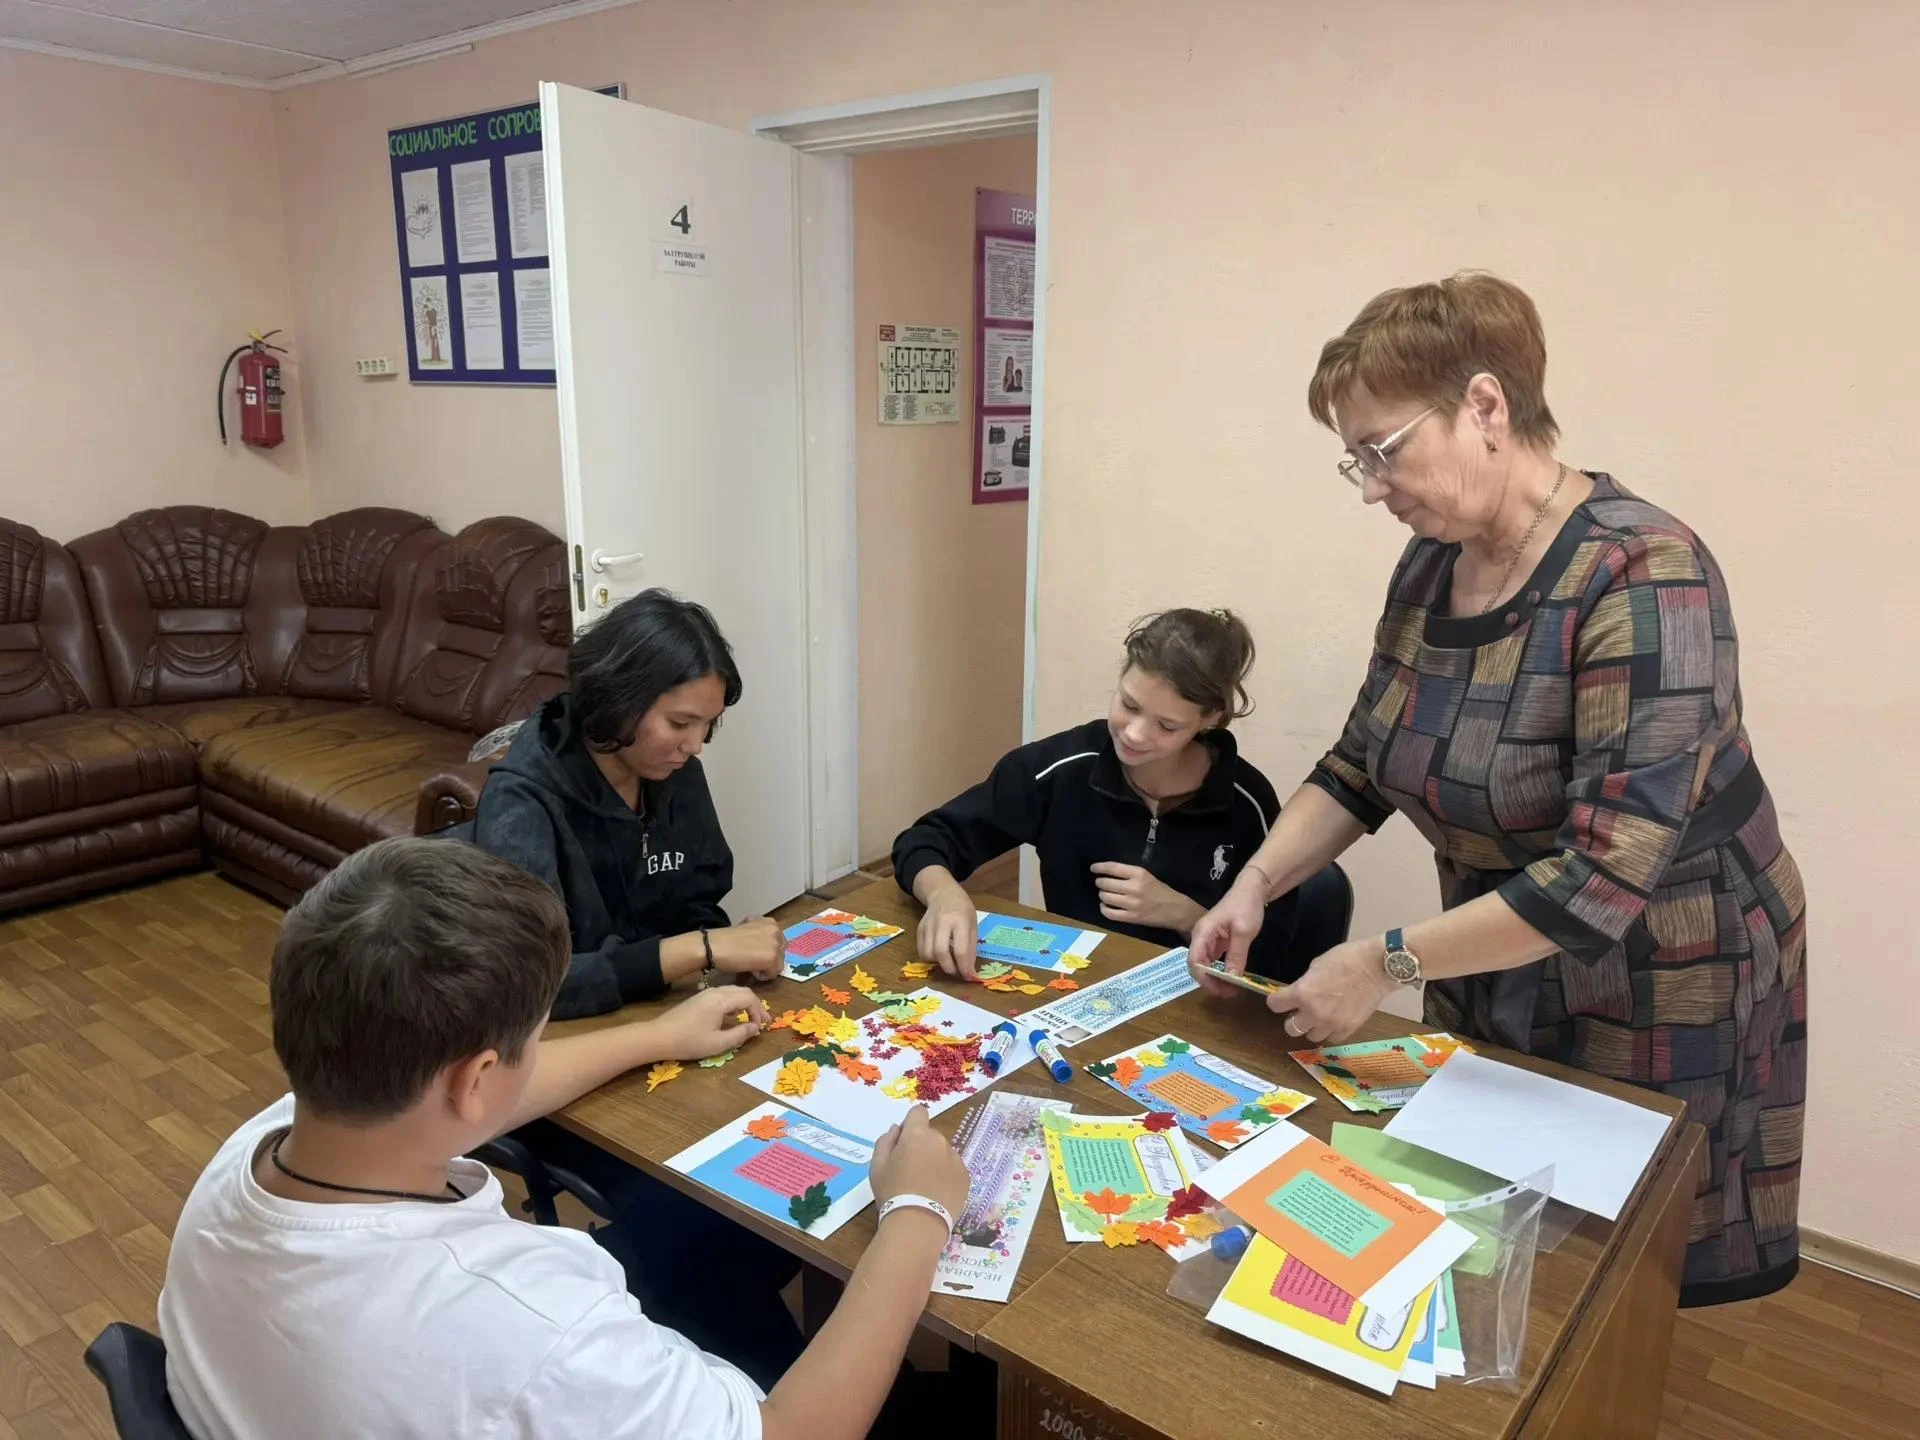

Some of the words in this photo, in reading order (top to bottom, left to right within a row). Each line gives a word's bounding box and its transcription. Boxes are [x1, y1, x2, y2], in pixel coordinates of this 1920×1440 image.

[389, 121, 478, 157] СОЦИАЛЬНОЕ
[670, 204, 691, 235] 4
[1010, 207, 1036, 226] ТЕРР
[647, 851, 684, 875] GAP
